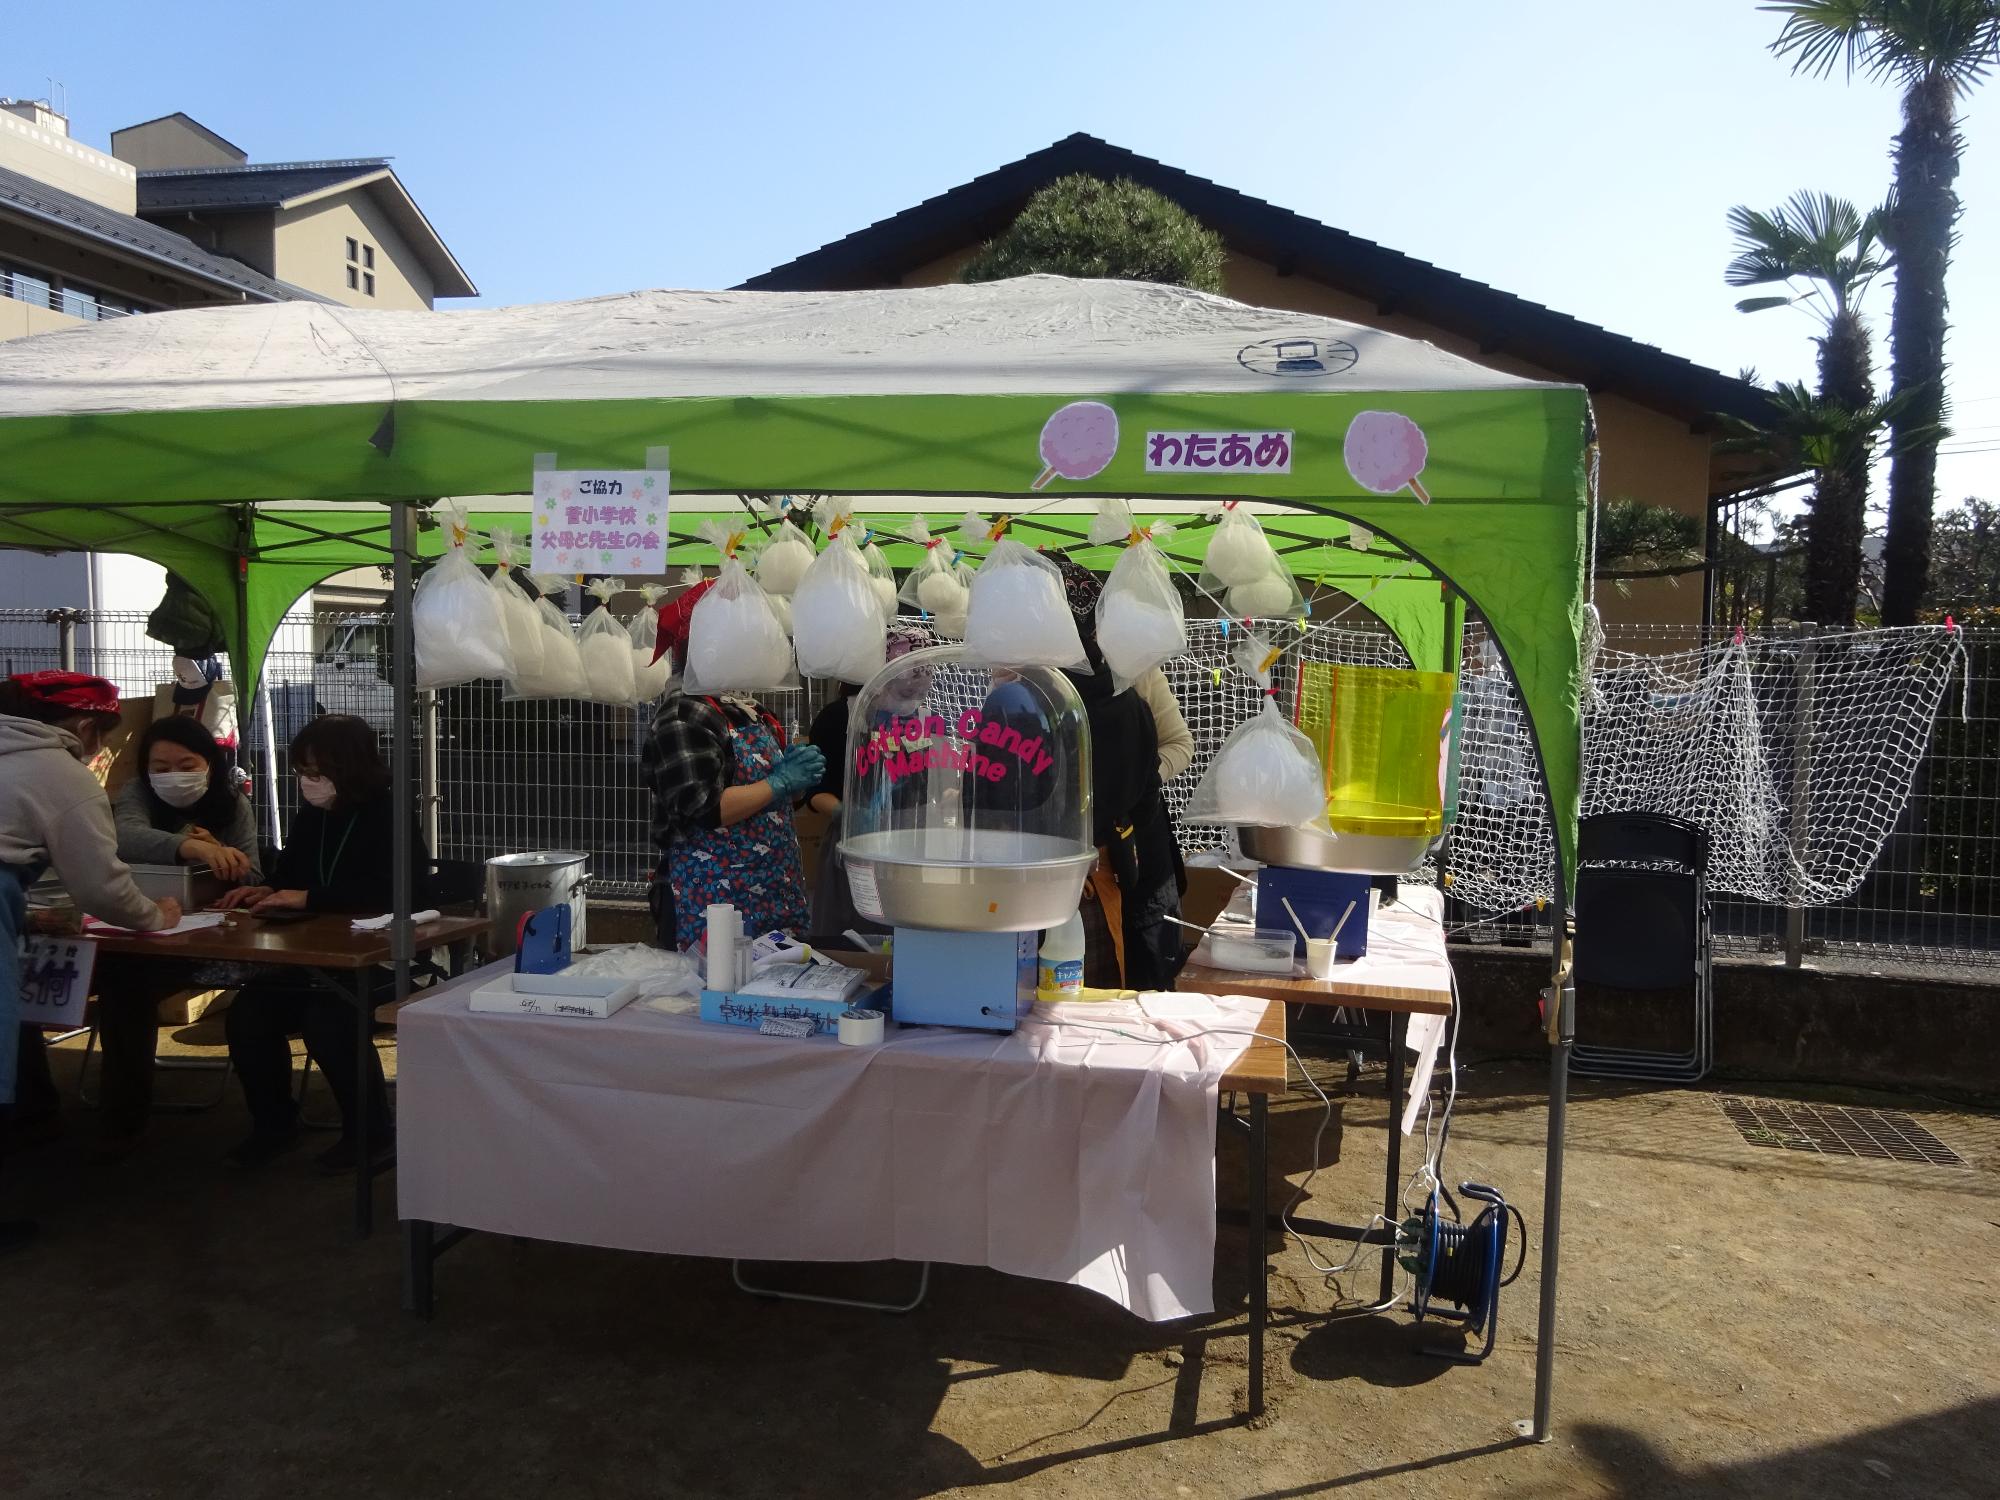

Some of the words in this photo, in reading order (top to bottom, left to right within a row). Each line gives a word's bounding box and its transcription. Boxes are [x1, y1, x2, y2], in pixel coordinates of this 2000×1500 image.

[1149, 434, 1288, 467] わたあめ
[580, 480, 622, 495] ご協力
[566, 507, 637, 525] 菅小学校
[542, 531, 660, 550] 父母と先生の会
[857, 713, 944, 776] Cotton
[957, 708, 1054, 776] Candy
[885, 743, 1006, 782] Machine
